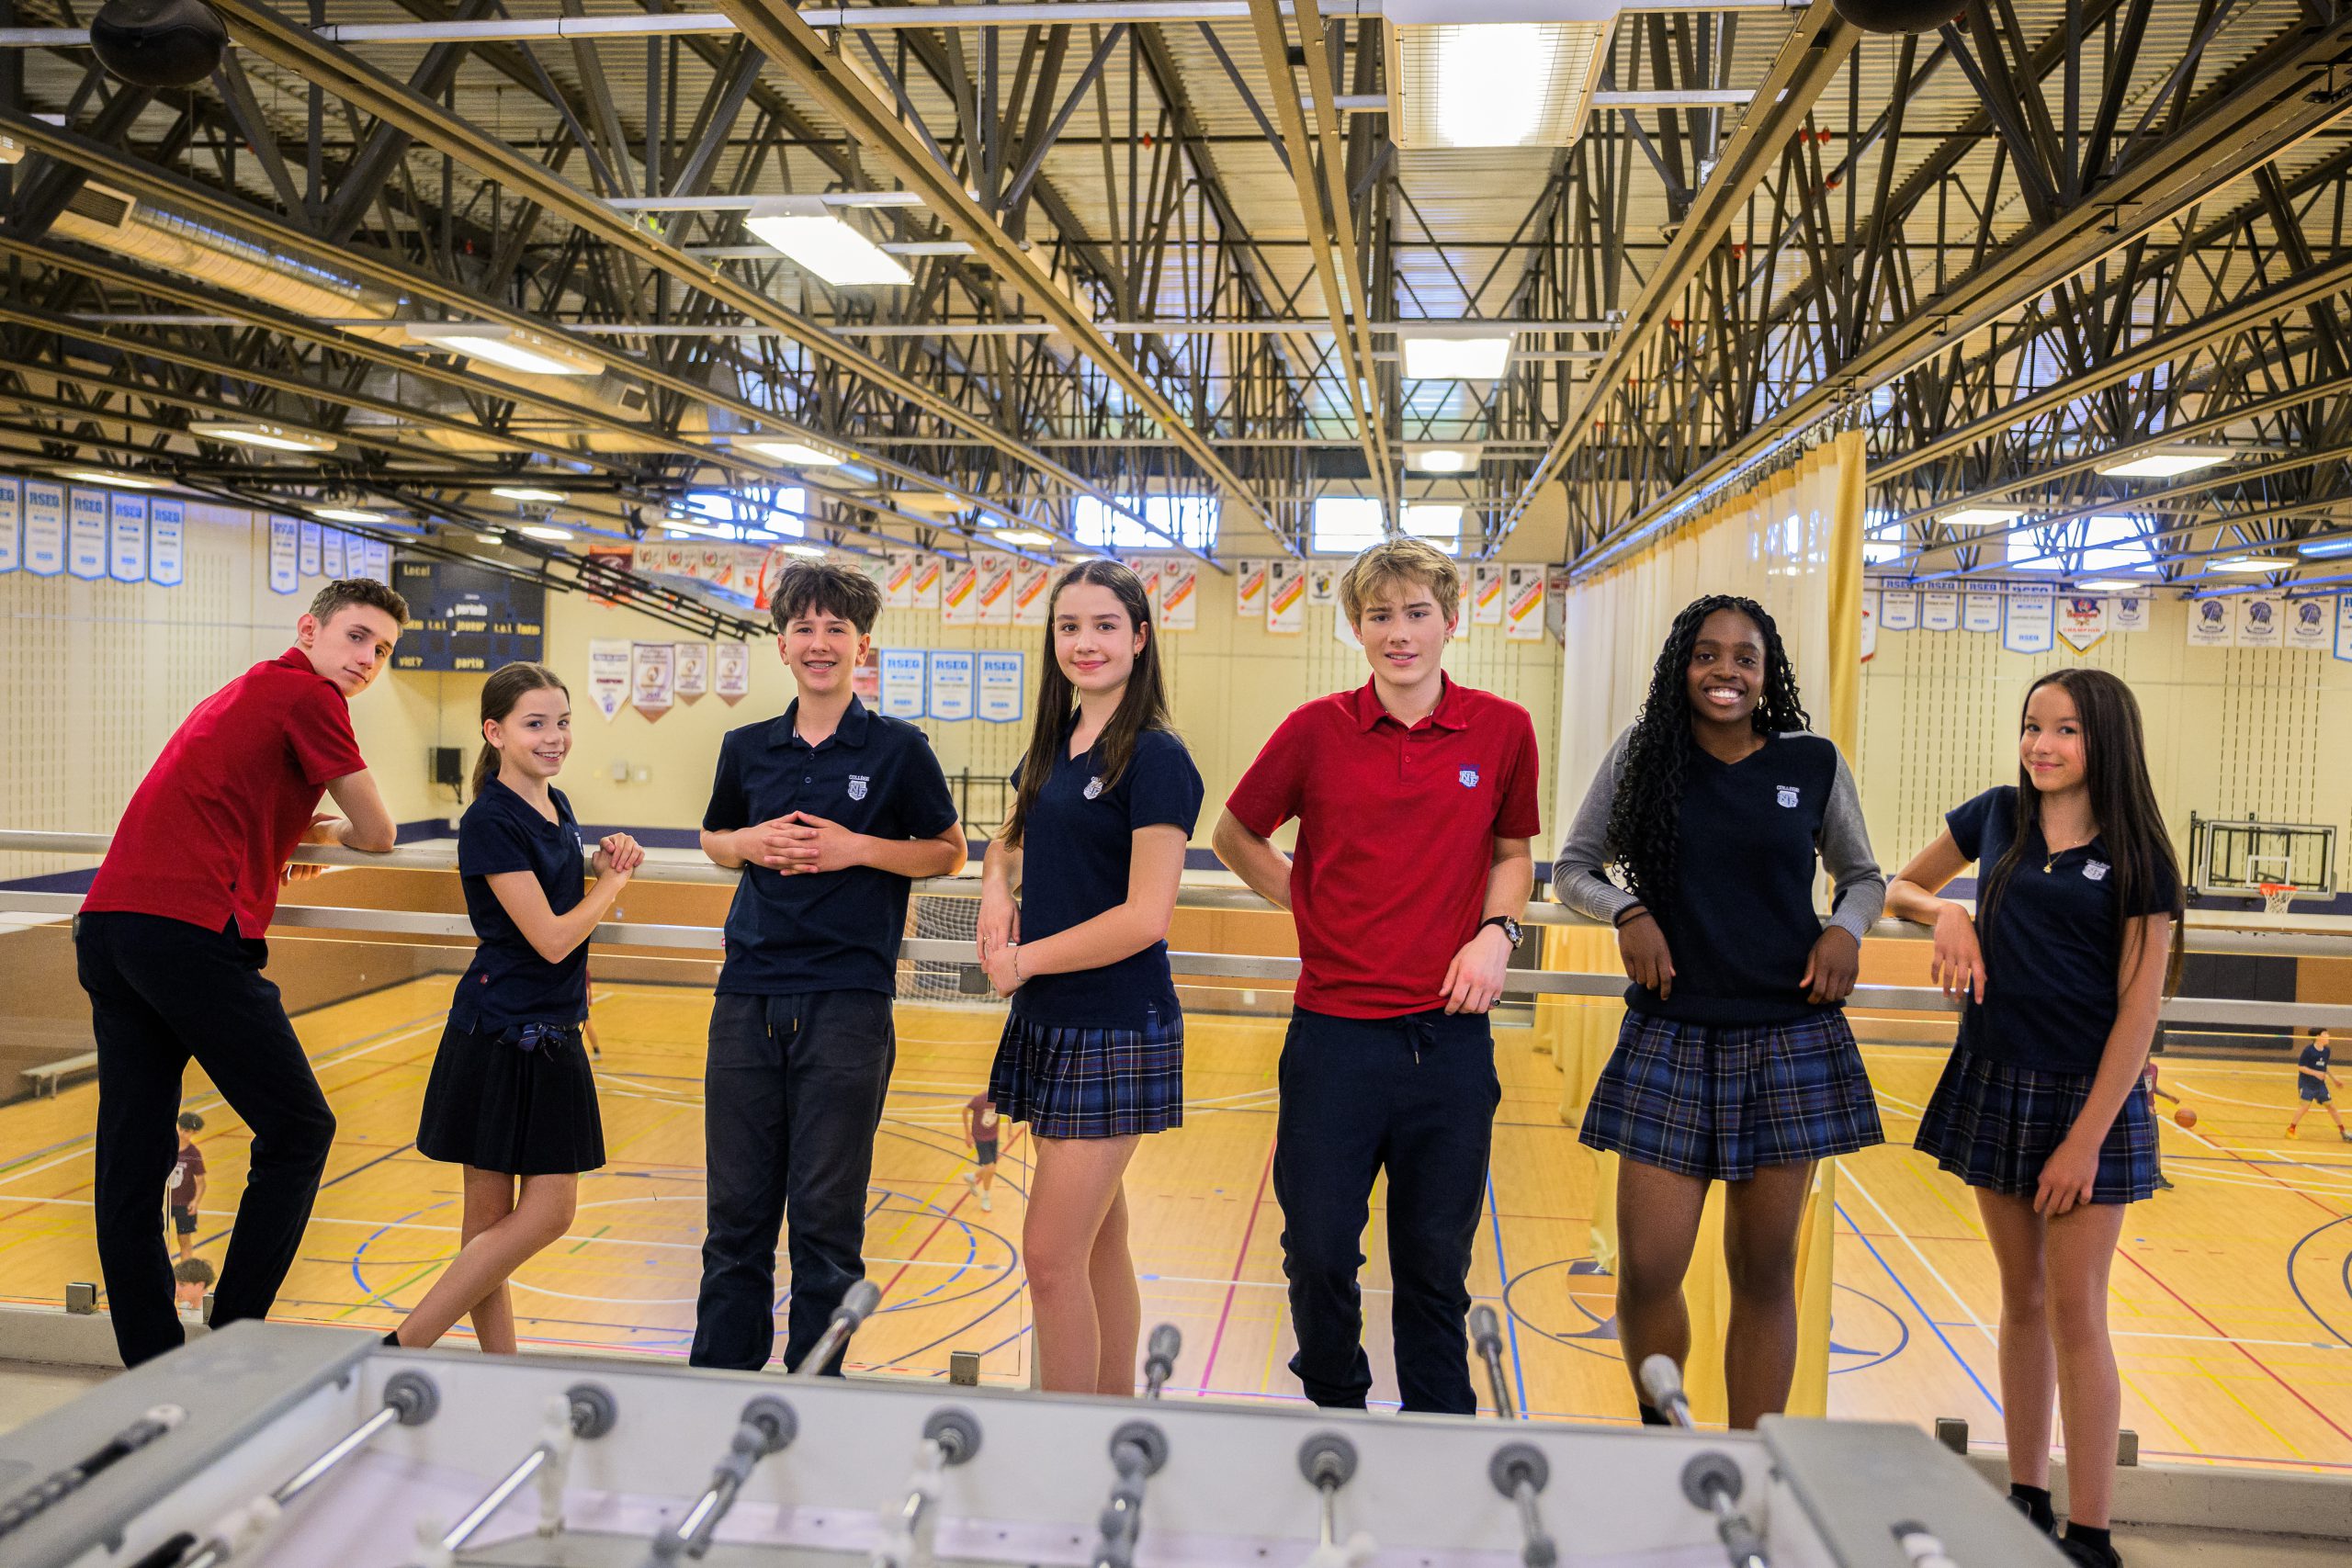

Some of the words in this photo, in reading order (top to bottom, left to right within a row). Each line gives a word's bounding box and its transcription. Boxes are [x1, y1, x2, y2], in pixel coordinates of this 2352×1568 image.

[29, 492, 60, 507] RSEQ
[74, 498, 103, 513] RSEQ
[116, 505, 141, 518] RSEQ
[154, 510, 179, 523] RSEQ
[888, 659, 920, 669] RSEQ
[936, 660, 968, 670] RSEQ
[984, 661, 1017, 671] RSEQ
